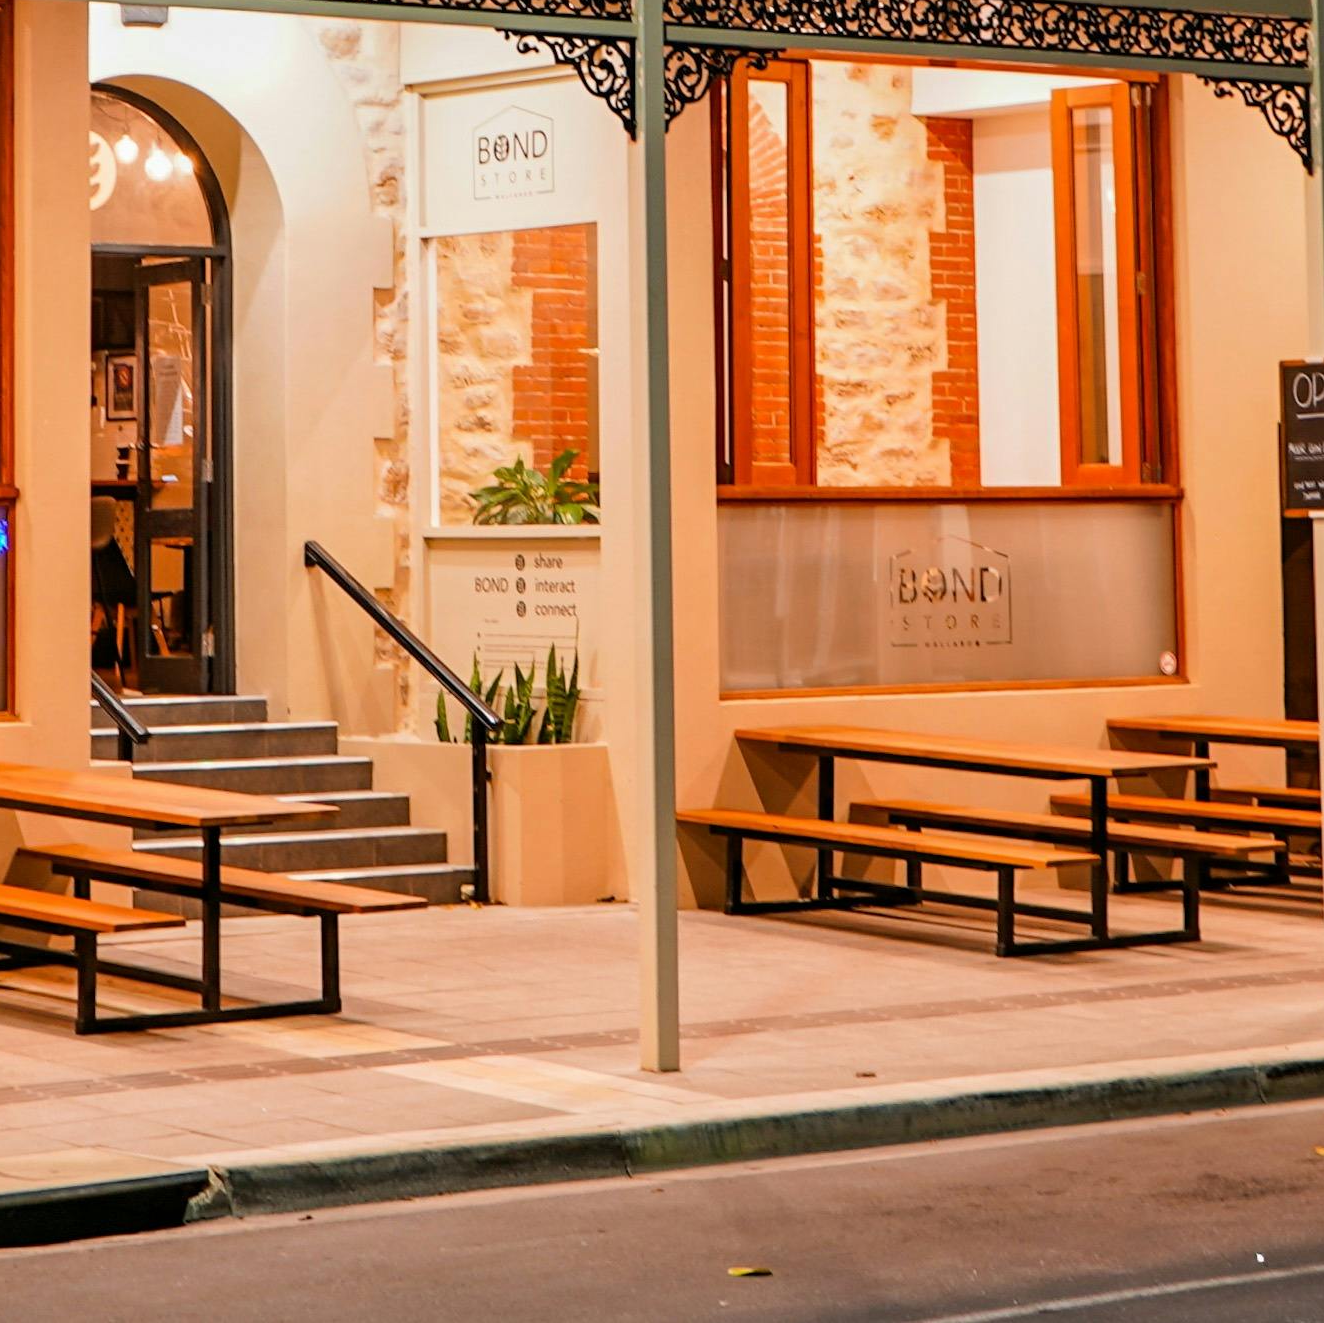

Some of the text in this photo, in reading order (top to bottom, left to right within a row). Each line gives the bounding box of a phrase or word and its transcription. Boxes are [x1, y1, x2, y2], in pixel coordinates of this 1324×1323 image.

[478, 129, 548, 165] BOND
[480, 167, 547, 188] STORE
[534, 553, 564, 569] share
[474, 576, 576, 594] BOND interact
[897, 565, 1002, 605] BOND
[534, 602, 577, 617] connect
[901, 612, 1002, 631] STORE
